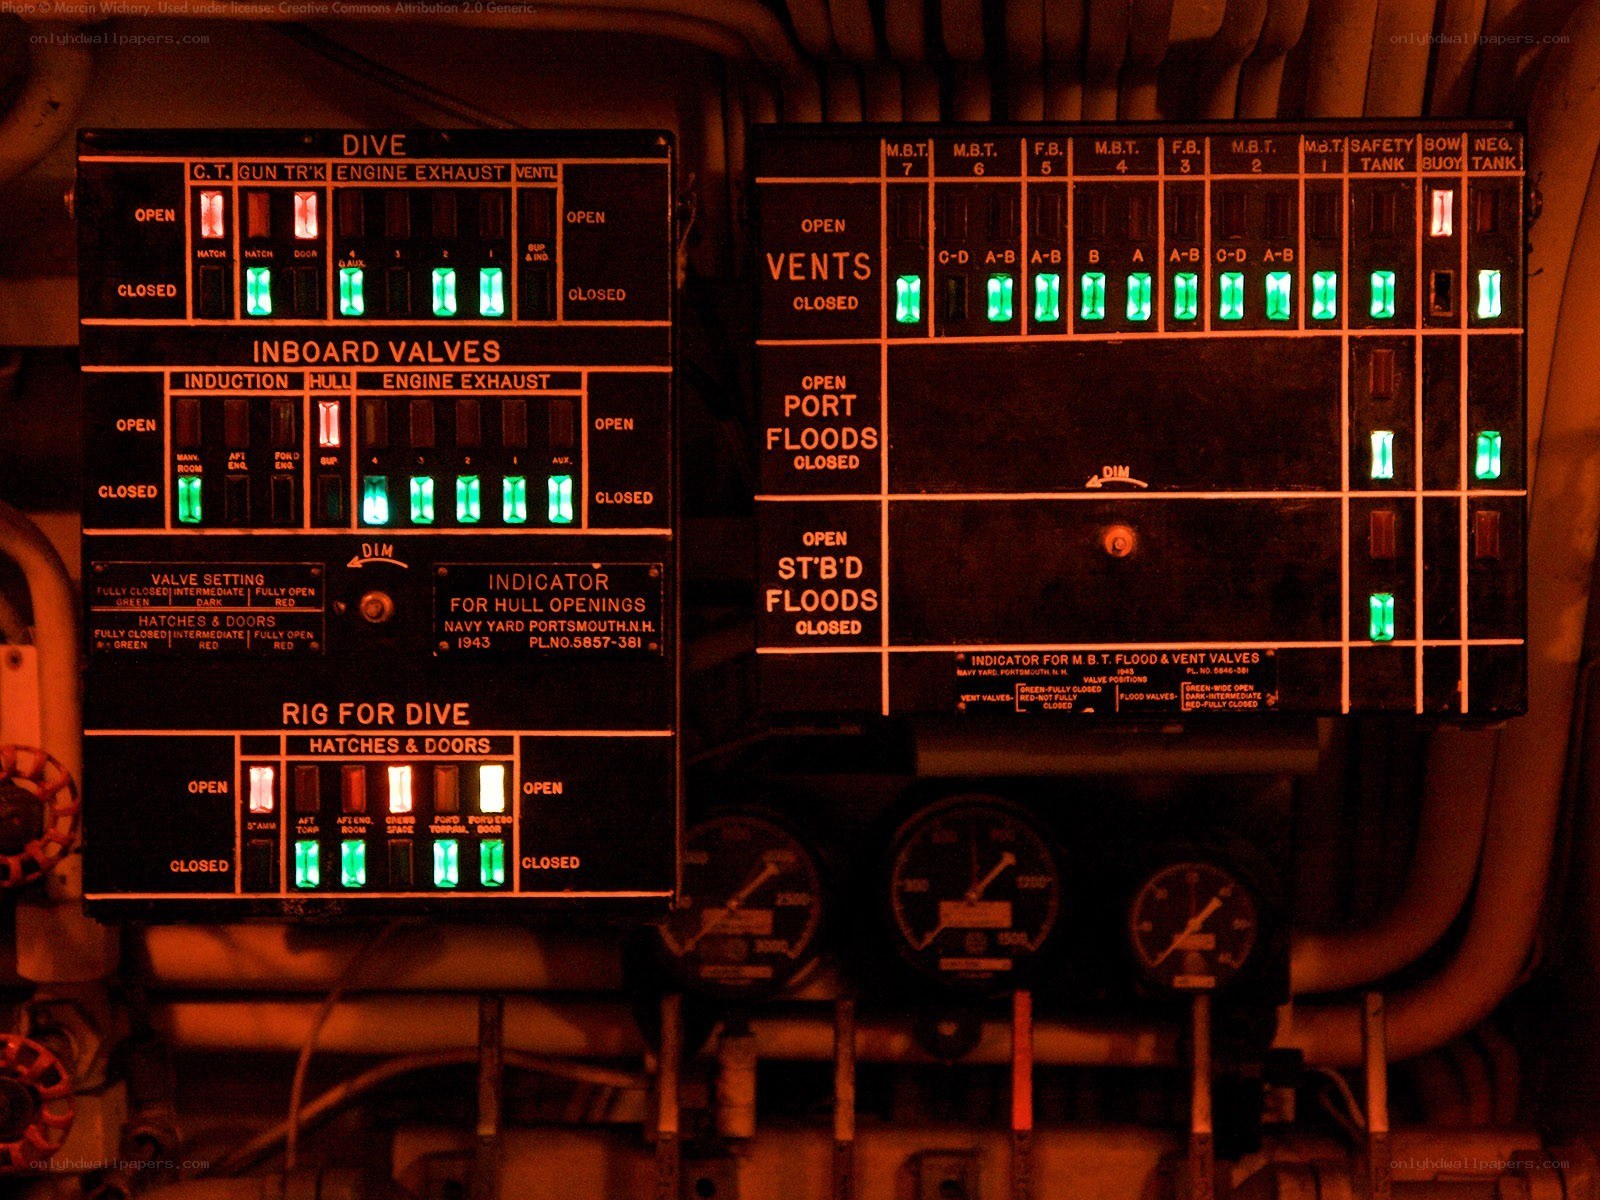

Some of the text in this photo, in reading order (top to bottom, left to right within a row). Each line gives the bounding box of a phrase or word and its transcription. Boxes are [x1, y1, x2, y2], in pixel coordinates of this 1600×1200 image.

[343, 135, 406, 155] DIVE
[887, 144, 928, 157] M.B.T.
[954, 143, 997, 156] M.B.T.
[1035, 142, 1063, 156] F.B.
[1095, 141, 1139, 154] M.B.T.
[1173, 141, 1200, 154] F.B.
[1232, 140, 1276, 153] M.B.T.
[1351, 139, 1414, 152] SAFETY
[1425, 138, 1460, 150] BOW
[1475, 138, 1513, 151] NEG.
[903, 163, 913, 176] 7
[974, 163, 984, 175] 6
[1041, 161, 1051, 174] 5
[1116, 160, 1128, 172] 4
[1181, 159, 1190, 172] 3
[1252, 159, 1262, 172] 2
[1361, 157, 1404, 171] TANK
[1422, 156, 1462, 170] BUOY
[1473, 156, 1516, 170] TANK
[194, 164, 231, 179] C.T.
[239, 164, 324, 179] GUN TR'K
[336, 165, 504, 180] ENGINE EXHAUST
[135, 208, 175, 222] OPEN
[566, 211, 605, 224] OPEN
[801, 218, 846, 232] OPEN
[197, 250, 226, 258] HATCH
[245, 250, 273, 258] HATCH
[294, 250, 317, 258] DOOR
[939, 251, 969, 264] C-D
[985, 250, 1015, 263] A-B
[1031, 250, 1061, 263] A-B
[1089, 250, 1099, 263] B
[1132, 249, 1144, 262] A
[1170, 248, 1200, 262] A-B
[1216, 248, 1246, 262] C-D
[1264, 248, 1294, 262] A-B
[766, 252, 871, 281] VENTS
[117, 284, 177, 297] CLOSED
[568, 288, 626, 301] CLOSED
[793, 296, 859, 310] CLOSED
[253, 340, 501, 363] INBOARD VALVES
[184, 373, 288, 389] INDUCTION
[310, 374, 350, 388] HULL
[383, 374, 550, 389] ENGINE EXHAUST
[801, 375, 847, 390] OPEN
[784, 394, 857, 417] PORT
[116, 419, 156, 432] OPEN
[594, 418, 634, 431] OPEN
[766, 427, 878, 451] FLOODS
[229, 452, 245, 460] AFT
[552, 456, 573, 464] AUX.
[793, 455, 860, 470] CLOSED
[177, 464, 203, 473] ROOM
[1103, 466, 1130, 478] DIM
[97, 485, 158, 499] CLOSED
[595, 491, 653, 504] CLOSED
[802, 531, 848, 547] OPEN
[361, 543, 394, 558] DIM
[777, 556, 863, 580] ST'B'D
[151, 573, 265, 586] VALVE SETTING
[489, 573, 609, 591] INDICATOR
[97, 586, 169, 596] FULLY CLOSED
[173, 586, 245, 596] INTERMEDIATE
[255, 587, 316, 597] FULLY OPEN
[116, 597, 149, 606] GREEN
[196, 598, 223, 606] DARK
[275, 598, 295, 607] RED
[450, 597, 647, 613] FOR HULL OPENINGS
[766, 589, 878, 613] FLOODS
[138, 615, 276, 628] HATCHES & DOORS
[444, 620, 482, 632] NAVY
[487, 620, 525, 632] YARD
[795, 620, 862, 636] CLOSED
[94, 629, 167, 639] FULLY CLOSED
[173, 629, 245, 639] INTERMEDIATE
[254, 630, 314, 640] FULLY OPEN
[113, 640, 148, 650] GREEN
[199, 641, 219, 650] RED
[273, 641, 294, 650] RED
[457, 636, 491, 649] 1943
[971, 655, 1039, 667] INDICATOR
[1043, 655, 1069, 666] FOR
[1114, 653, 1158, 665] FLOOD
[1160, 653, 1170, 664] &
[1172, 652, 1206, 664] VENT
[1209, 652, 1260, 664] VALVES
[1083, 676, 1148, 684] VALVE POSITIONS
[1233, 684, 1255, 692] OPEN
[960, 694, 981, 702] VENT
[1054, 693, 1078, 701] FULLY
[1119, 692, 1145, 701] FLOOD
[1042, 702, 1073, 710] CLOSED
[1228, 700, 1259, 708] CLOSED
[282, 702, 470, 725] RIG FOR DIVE
[309, 738, 491, 753] HATCHES & DOORS
[187, 781, 228, 793] OPEN
[523, 782, 563, 795] OPEN
[341, 825, 367, 834] ROOM
[169, 859, 229, 872] CLOSED
[521, 856, 580, 869] CLOSED
